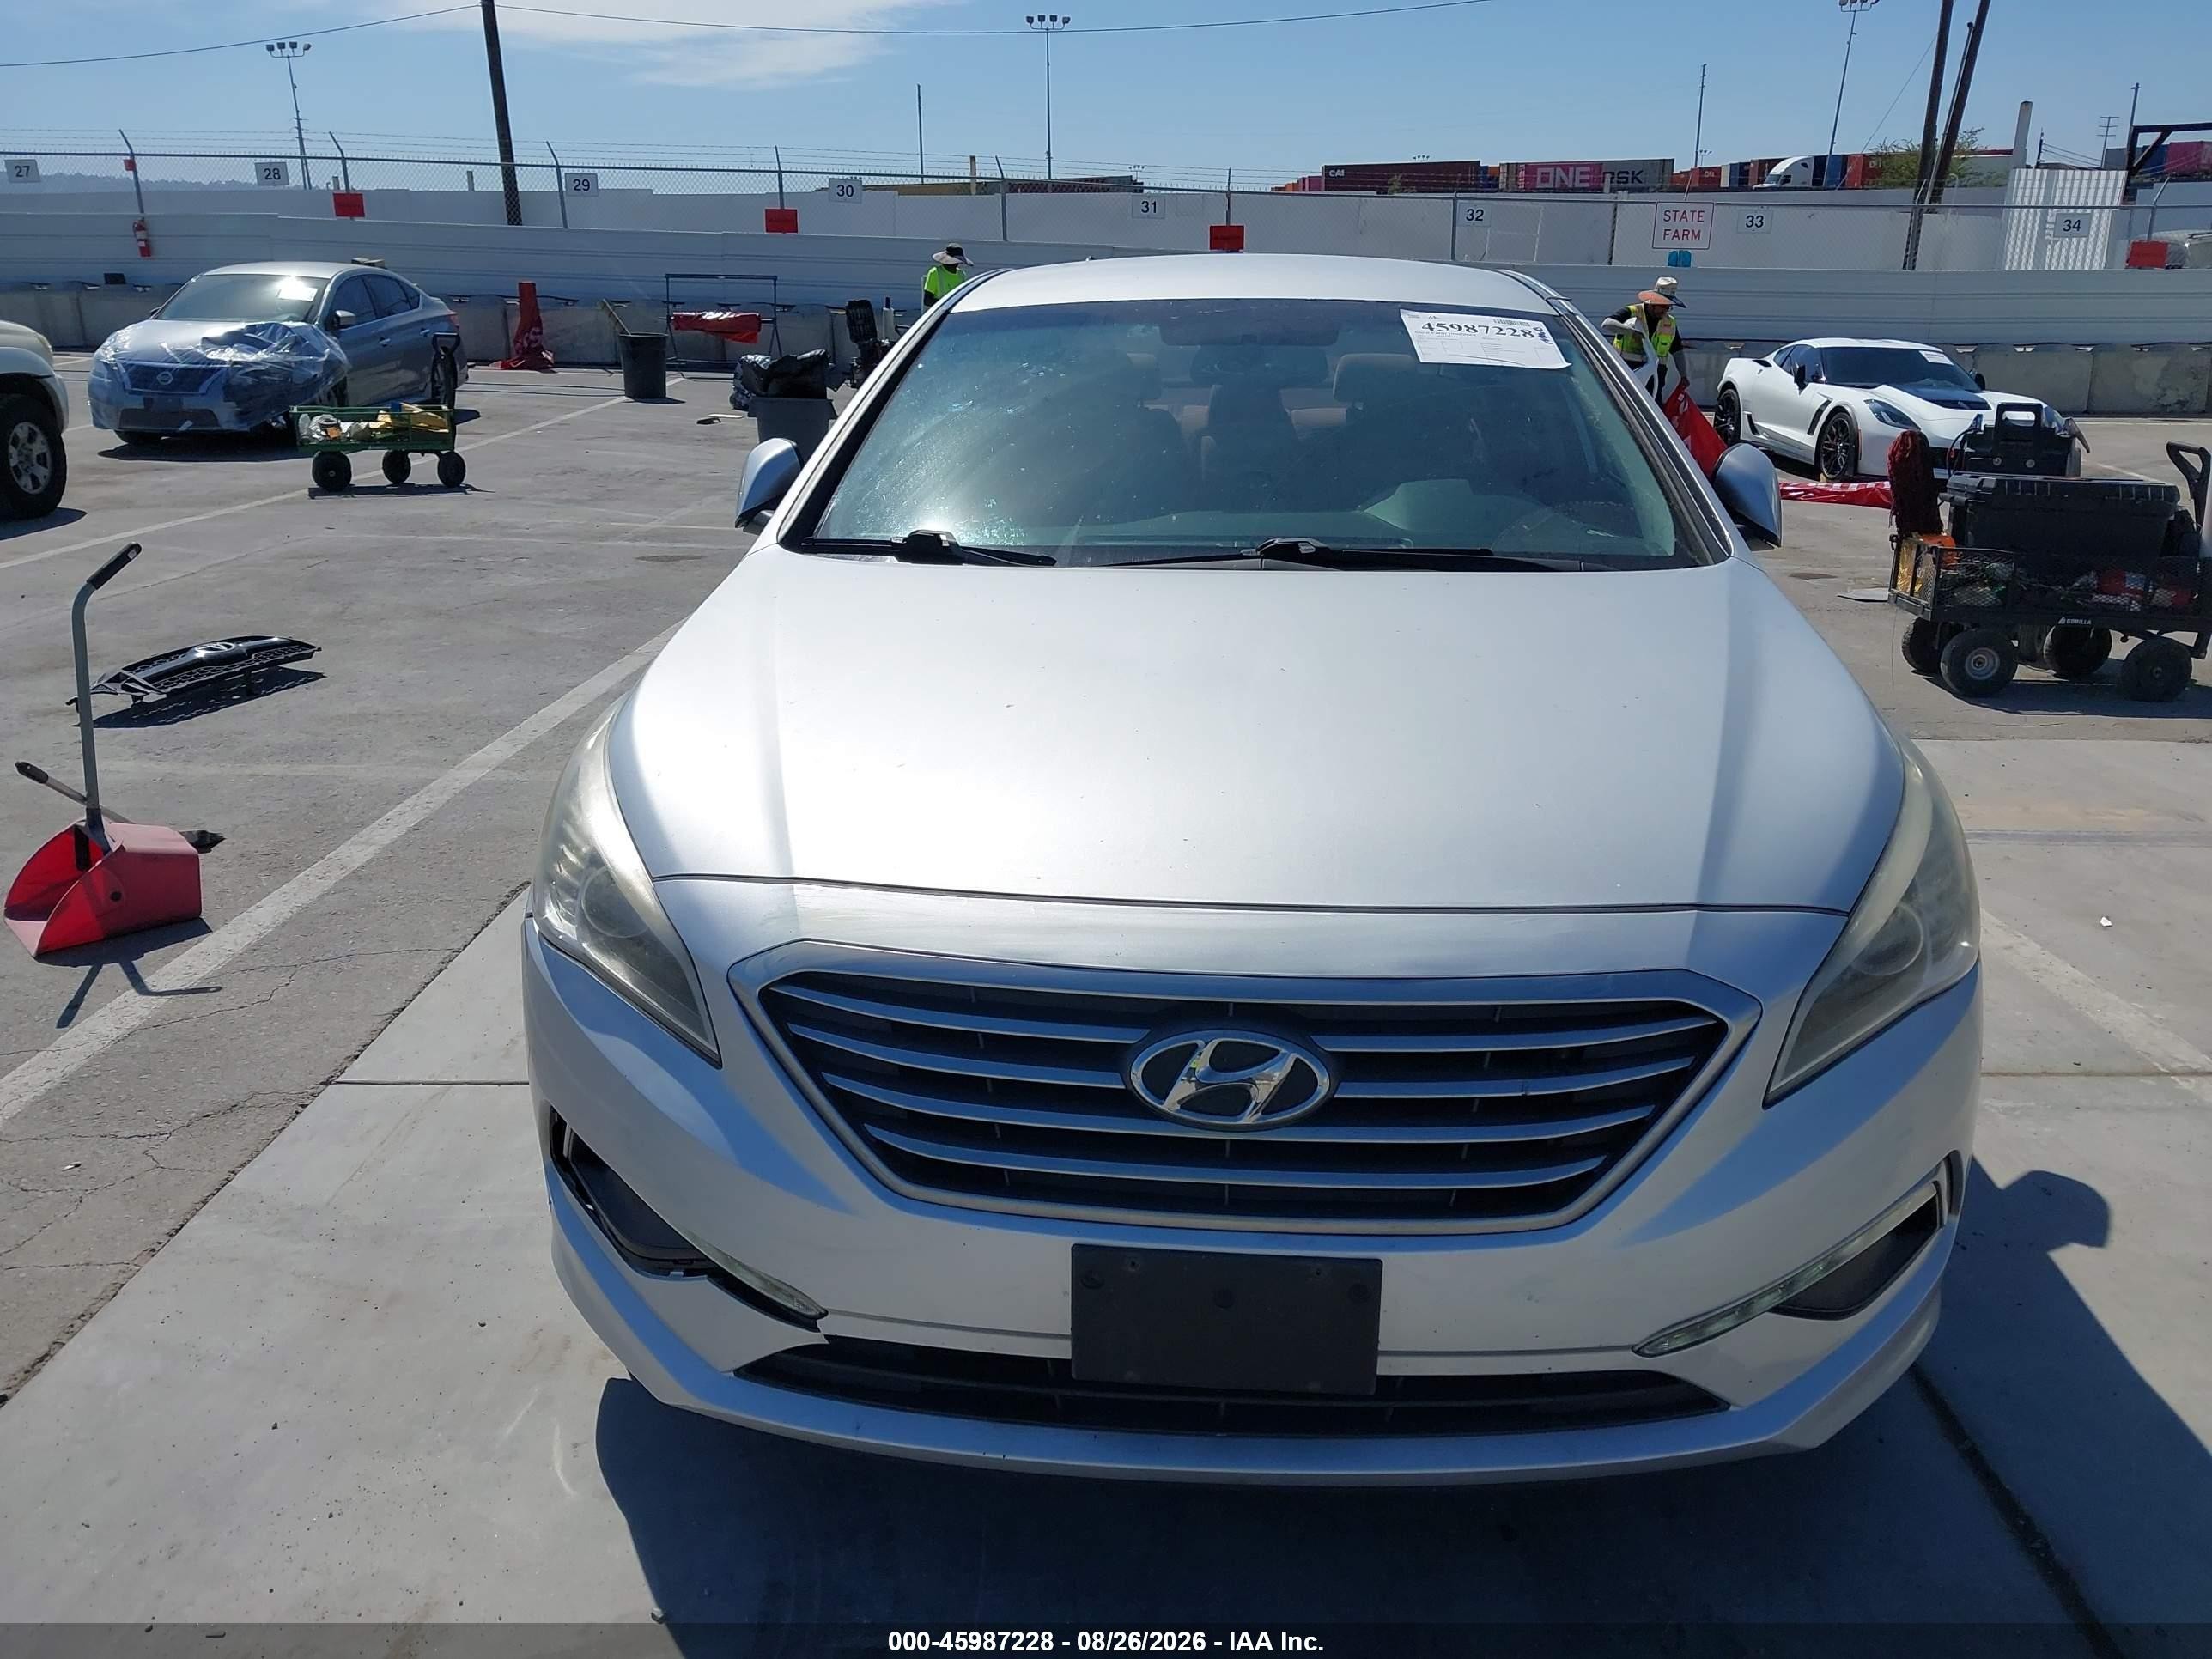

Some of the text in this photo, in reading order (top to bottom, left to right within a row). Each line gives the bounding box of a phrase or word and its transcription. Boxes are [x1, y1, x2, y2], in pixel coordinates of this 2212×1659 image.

[14, 165, 30, 178] 27
[264, 167, 281, 180] 28
[1536, 166, 1591, 188] ONE
[573, 179, 591, 191] 29
[836, 184, 854, 198] 30
[1140, 200, 1158, 214] 31
[1466, 208, 1485, 222] 32
[1662, 210, 1705, 223] STATE
[1745, 215, 1764, 228] 33
[2063, 219, 2081, 232] 34
[1662, 228, 1701, 241] FARM
[1421, 322, 1534, 338] 45987228
